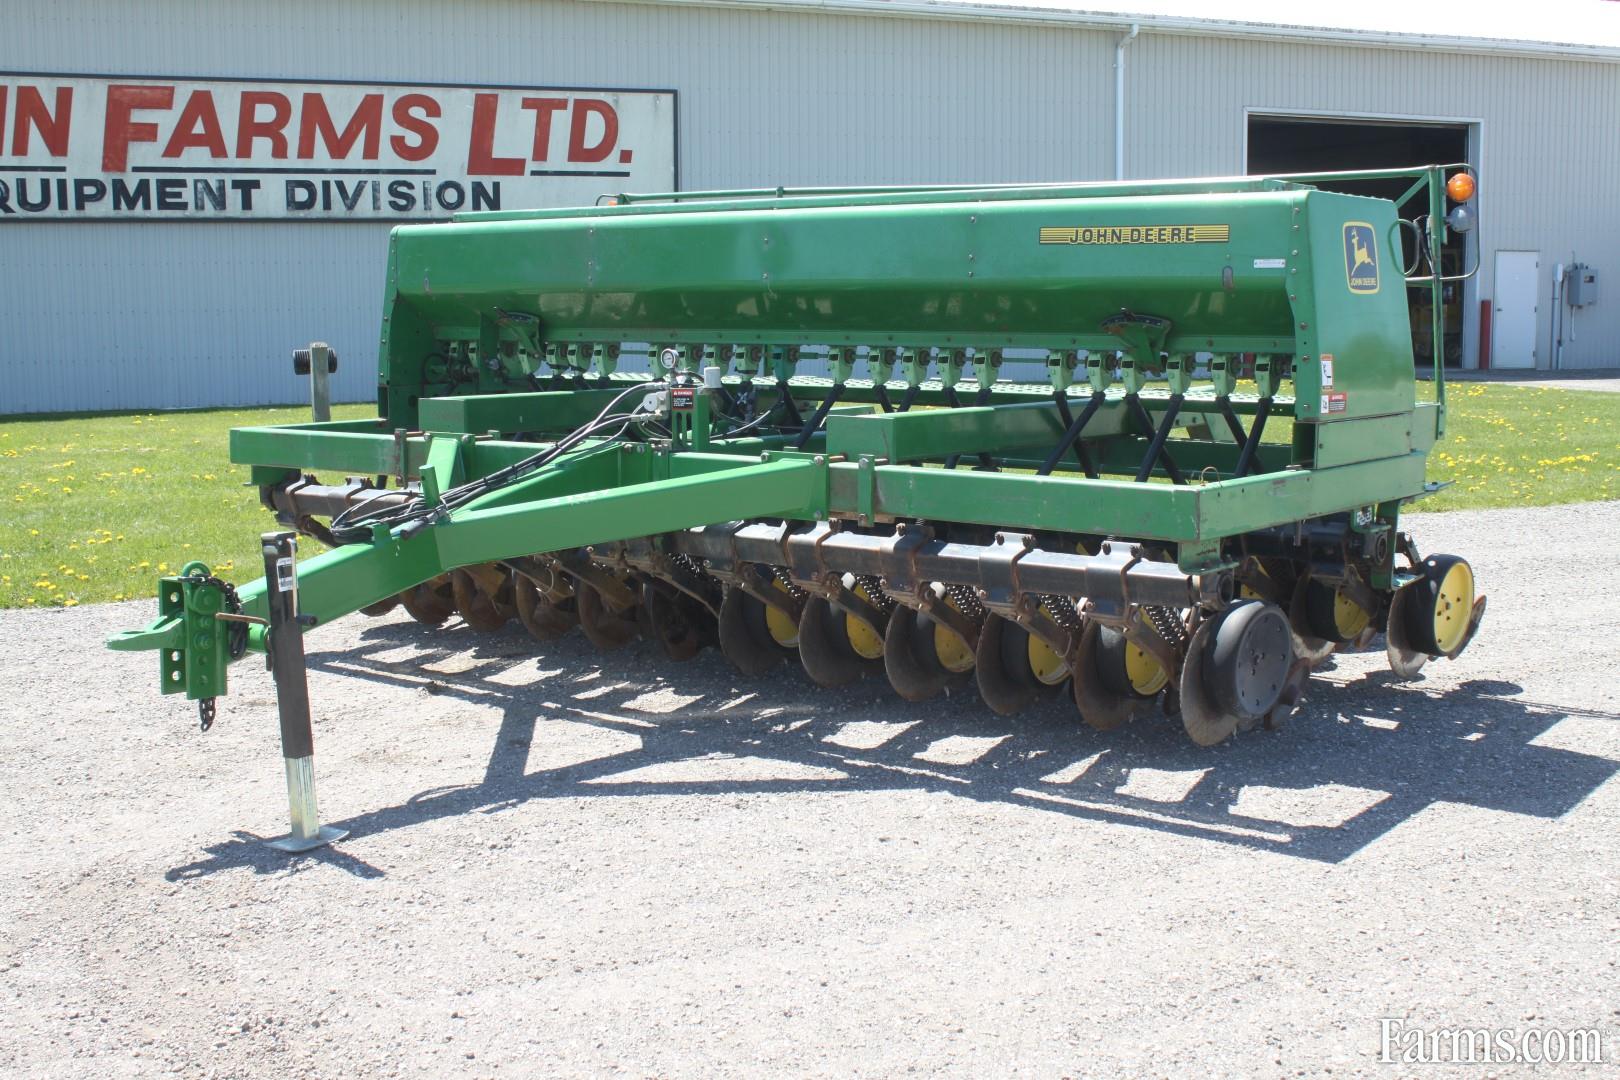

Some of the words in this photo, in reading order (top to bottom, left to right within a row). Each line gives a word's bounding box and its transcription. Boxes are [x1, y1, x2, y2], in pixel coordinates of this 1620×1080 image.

[101, 84, 442, 173] FARMS
[467, 93, 632, 176] LTD.
[285, 179, 501, 211] DIVISION
[1070, 228, 1122, 243] JOHN
[1130, 227, 1194, 243] DEERE
